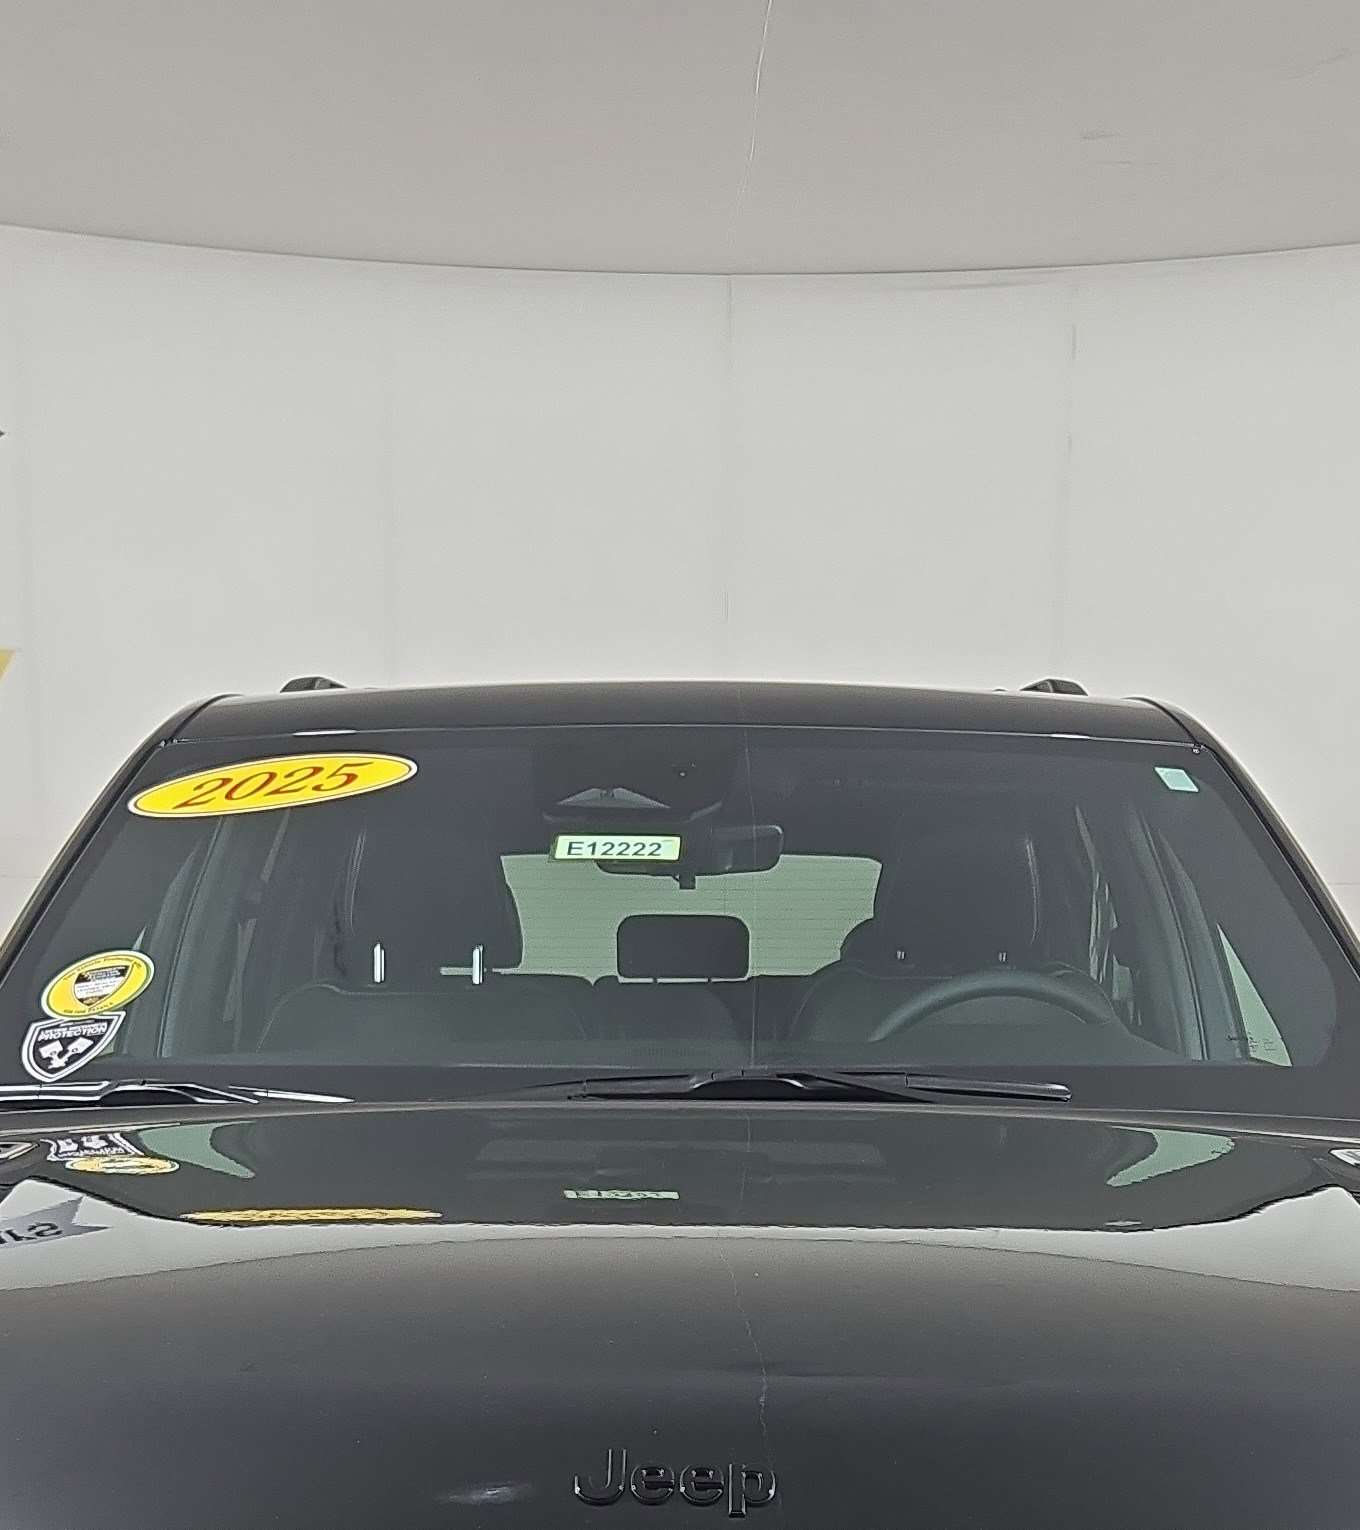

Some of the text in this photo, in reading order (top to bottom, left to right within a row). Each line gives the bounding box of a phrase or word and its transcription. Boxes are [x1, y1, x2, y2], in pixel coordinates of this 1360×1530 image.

[172, 761, 374, 810] 2025
[566, 840, 662, 857] E12222
[574, 1448, 777, 1518] Jeep
